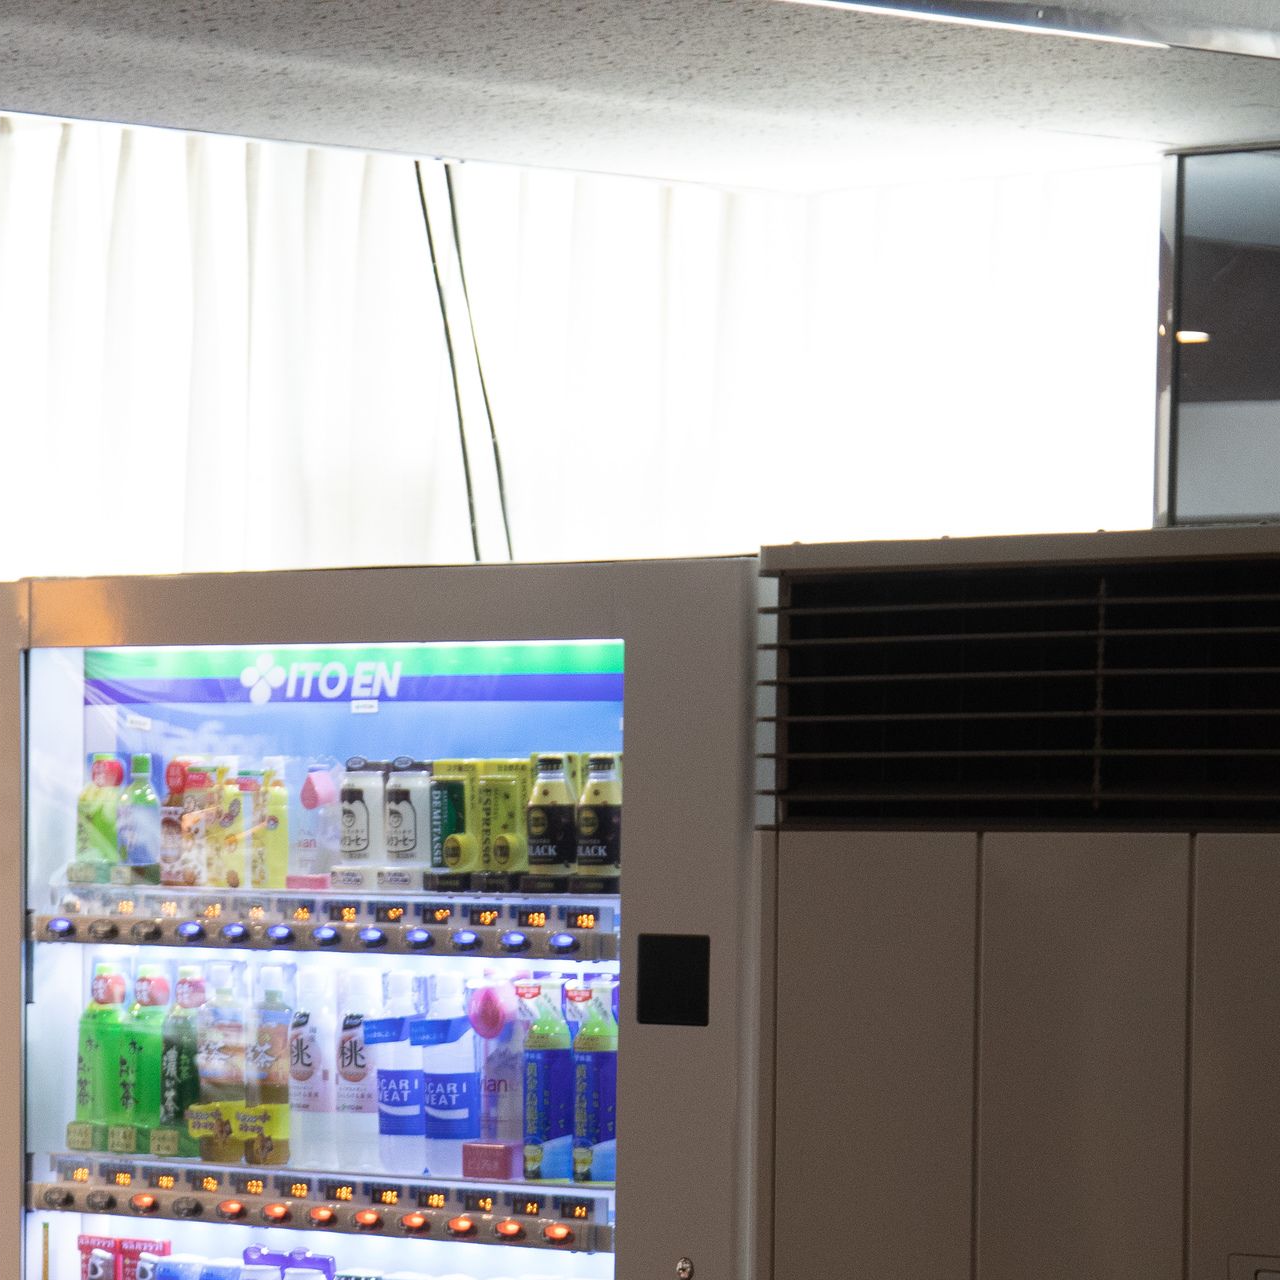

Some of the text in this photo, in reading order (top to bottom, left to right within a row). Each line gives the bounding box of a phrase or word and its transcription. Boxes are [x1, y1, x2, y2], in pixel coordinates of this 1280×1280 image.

[285, 660, 403, 698] ITO EN
[338, 1039, 368, 1070] 桃
